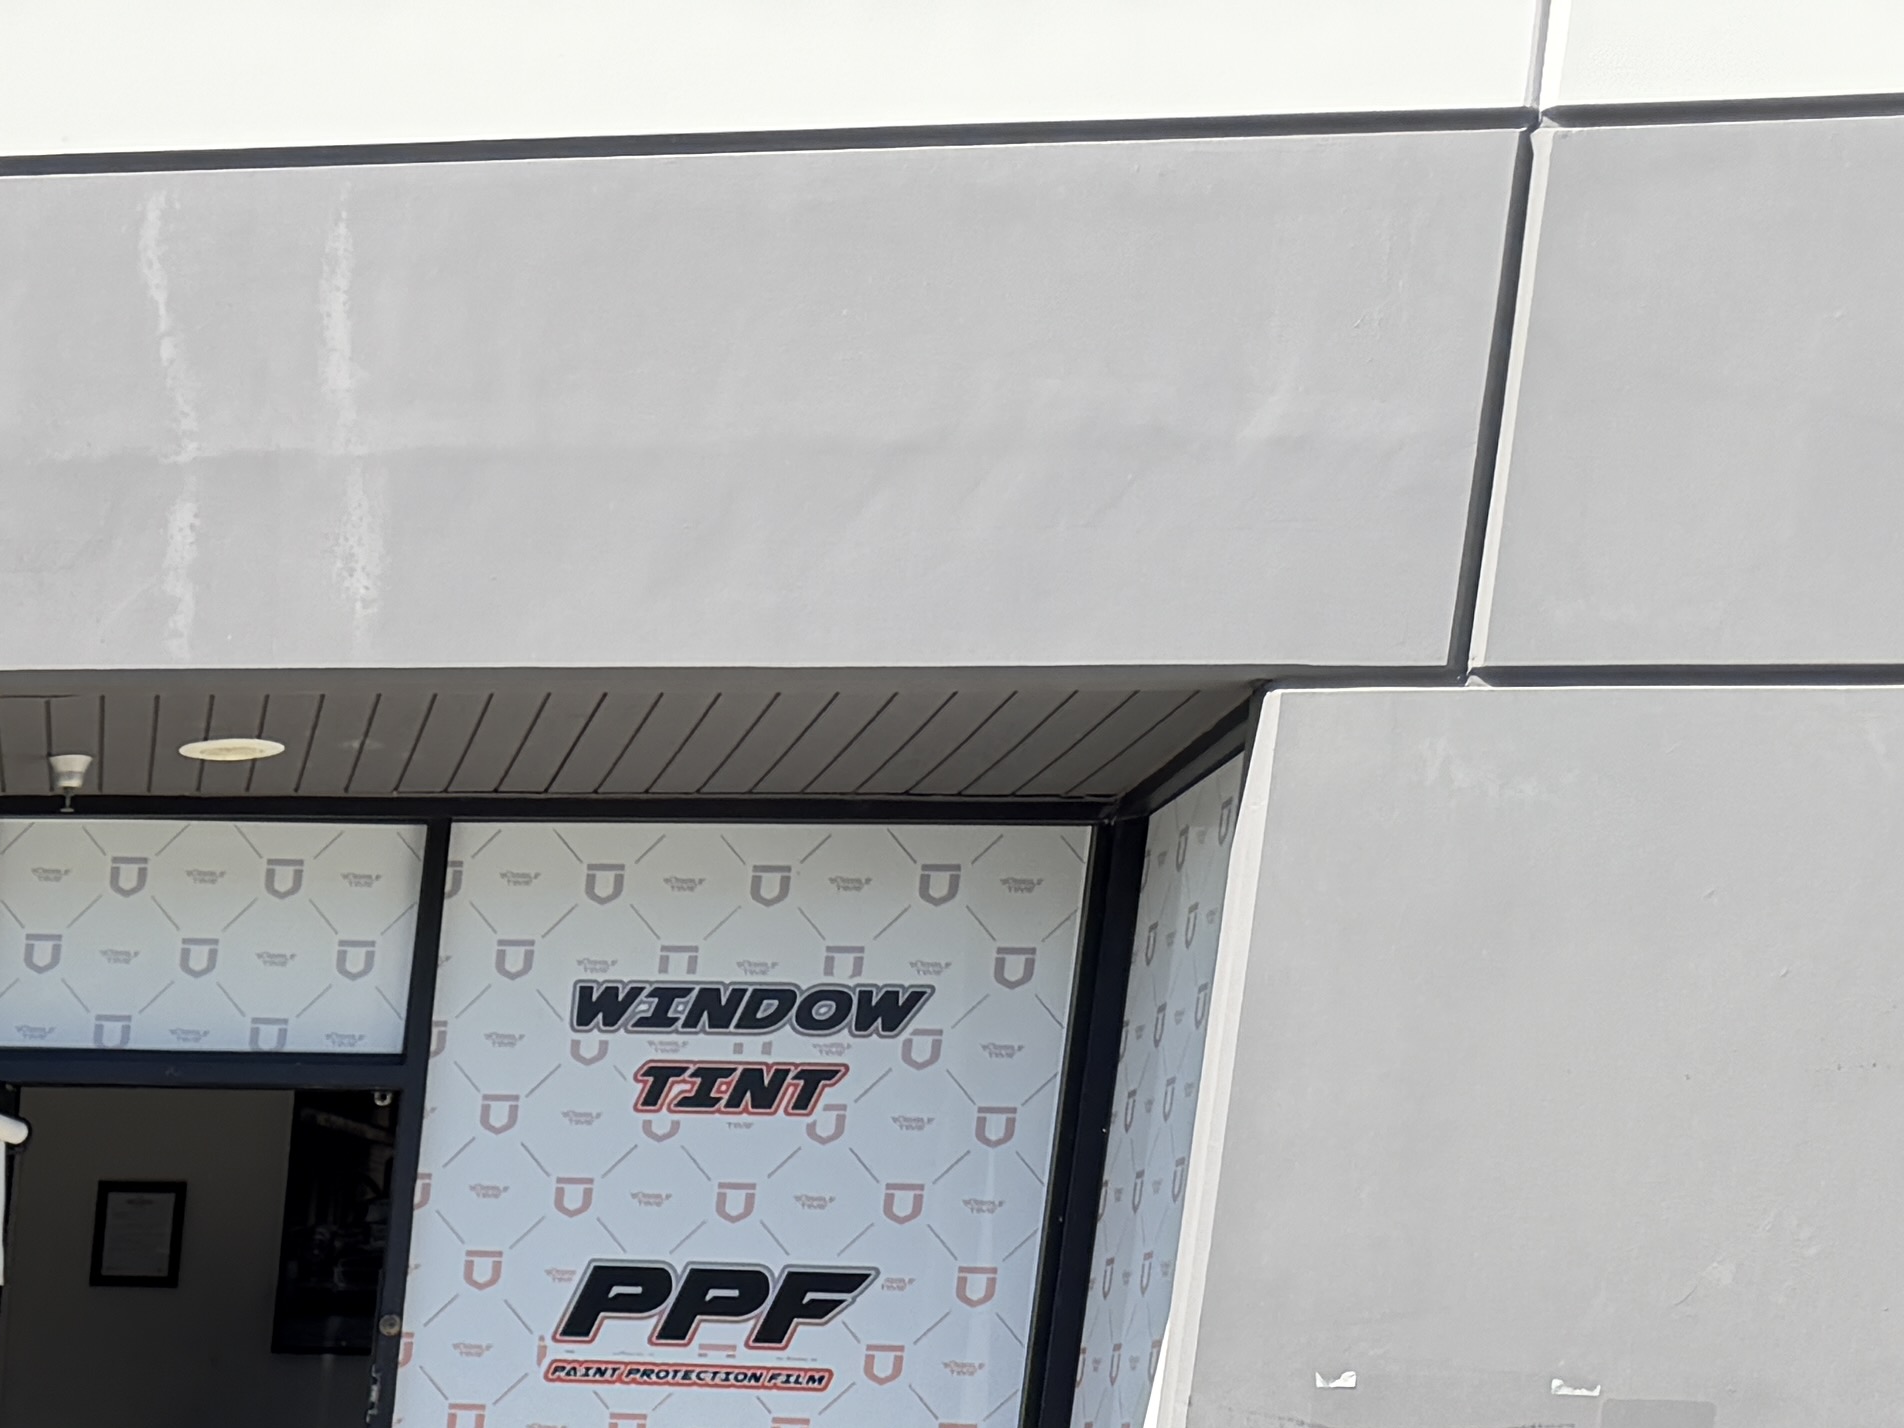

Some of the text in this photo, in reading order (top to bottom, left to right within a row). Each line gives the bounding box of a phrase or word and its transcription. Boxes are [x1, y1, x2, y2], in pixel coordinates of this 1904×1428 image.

[572, 981, 934, 1037] WINDOW
[633, 1059, 849, 1117] TINT
[551, 1258, 881, 1351] PPF
[549, 1363, 828, 1388] PAINT PROTECTION FILM
